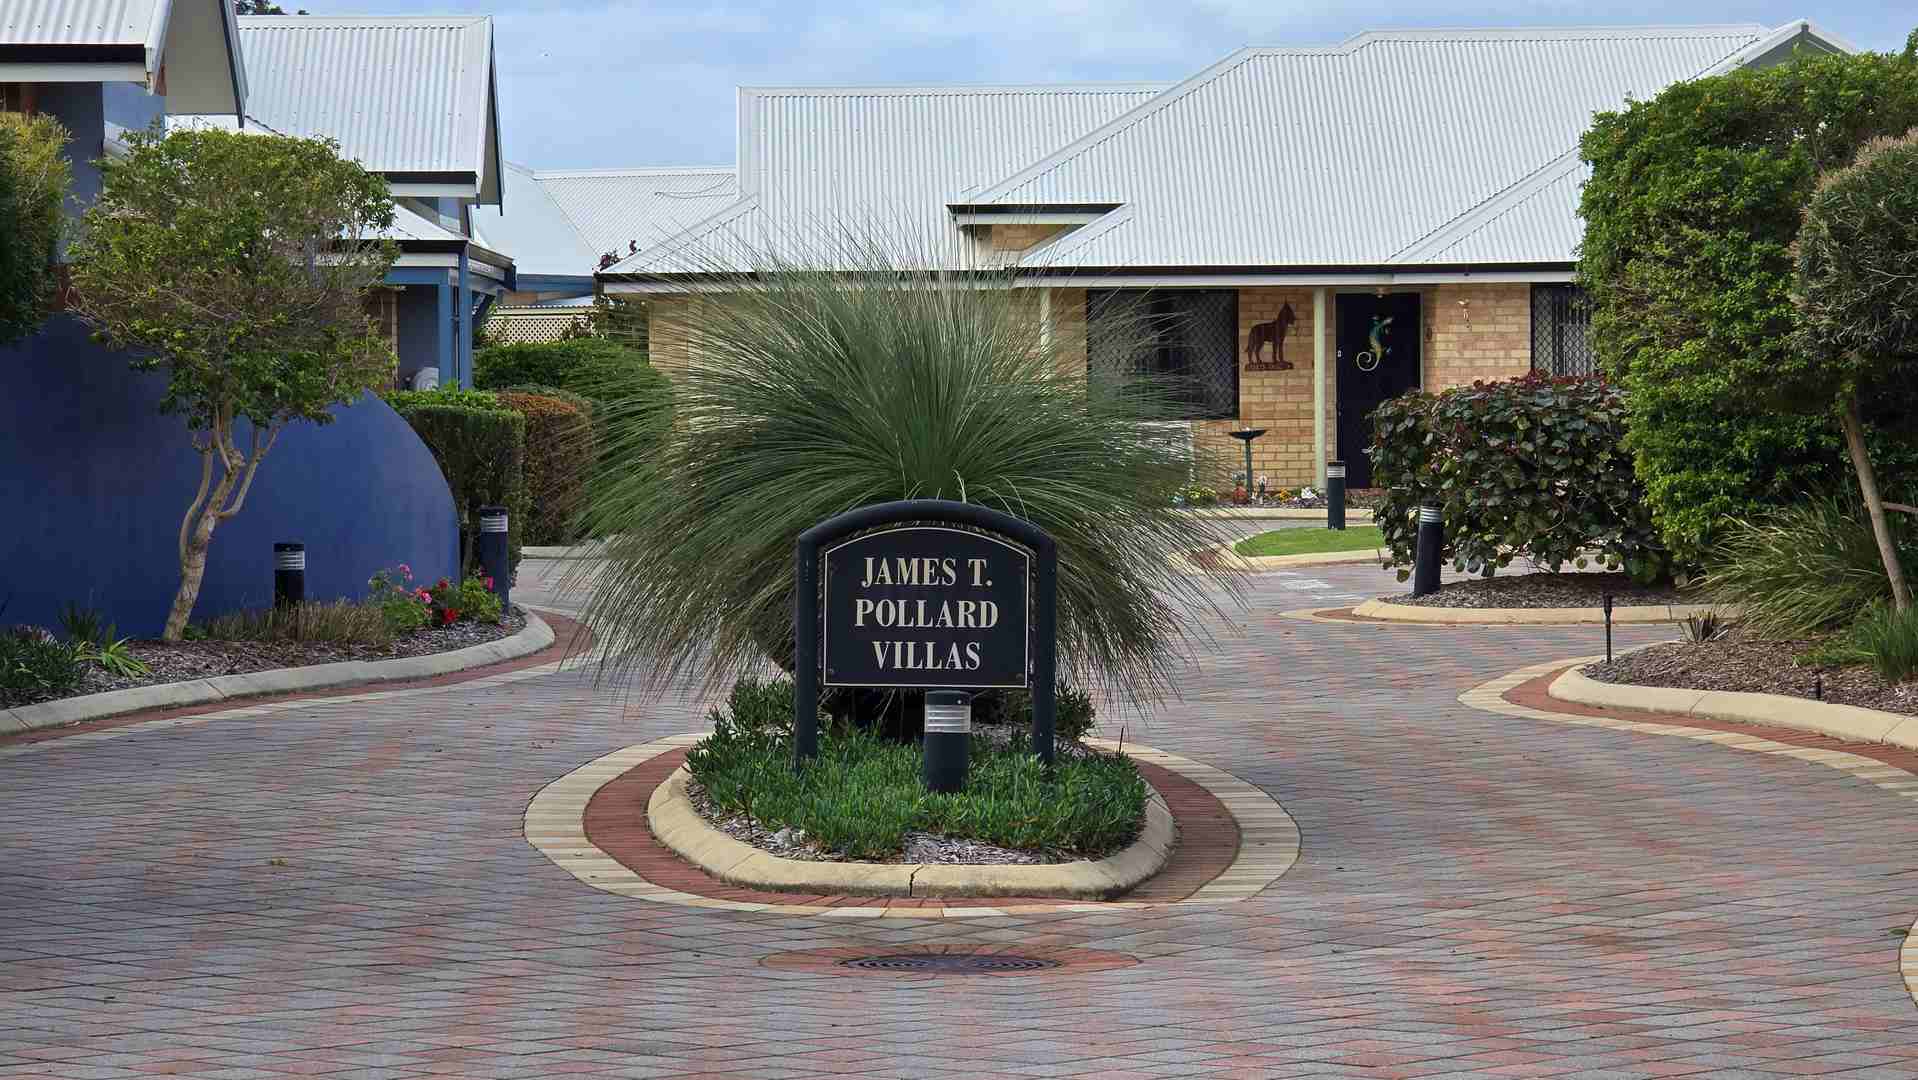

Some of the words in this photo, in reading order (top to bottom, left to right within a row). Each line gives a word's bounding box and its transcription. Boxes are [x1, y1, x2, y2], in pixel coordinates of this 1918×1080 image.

[862, 557, 956, 588] JAMES
[968, 558, 993, 587] T.
[855, 599, 999, 628] POLLARD
[872, 641, 981, 670] VILLAS
